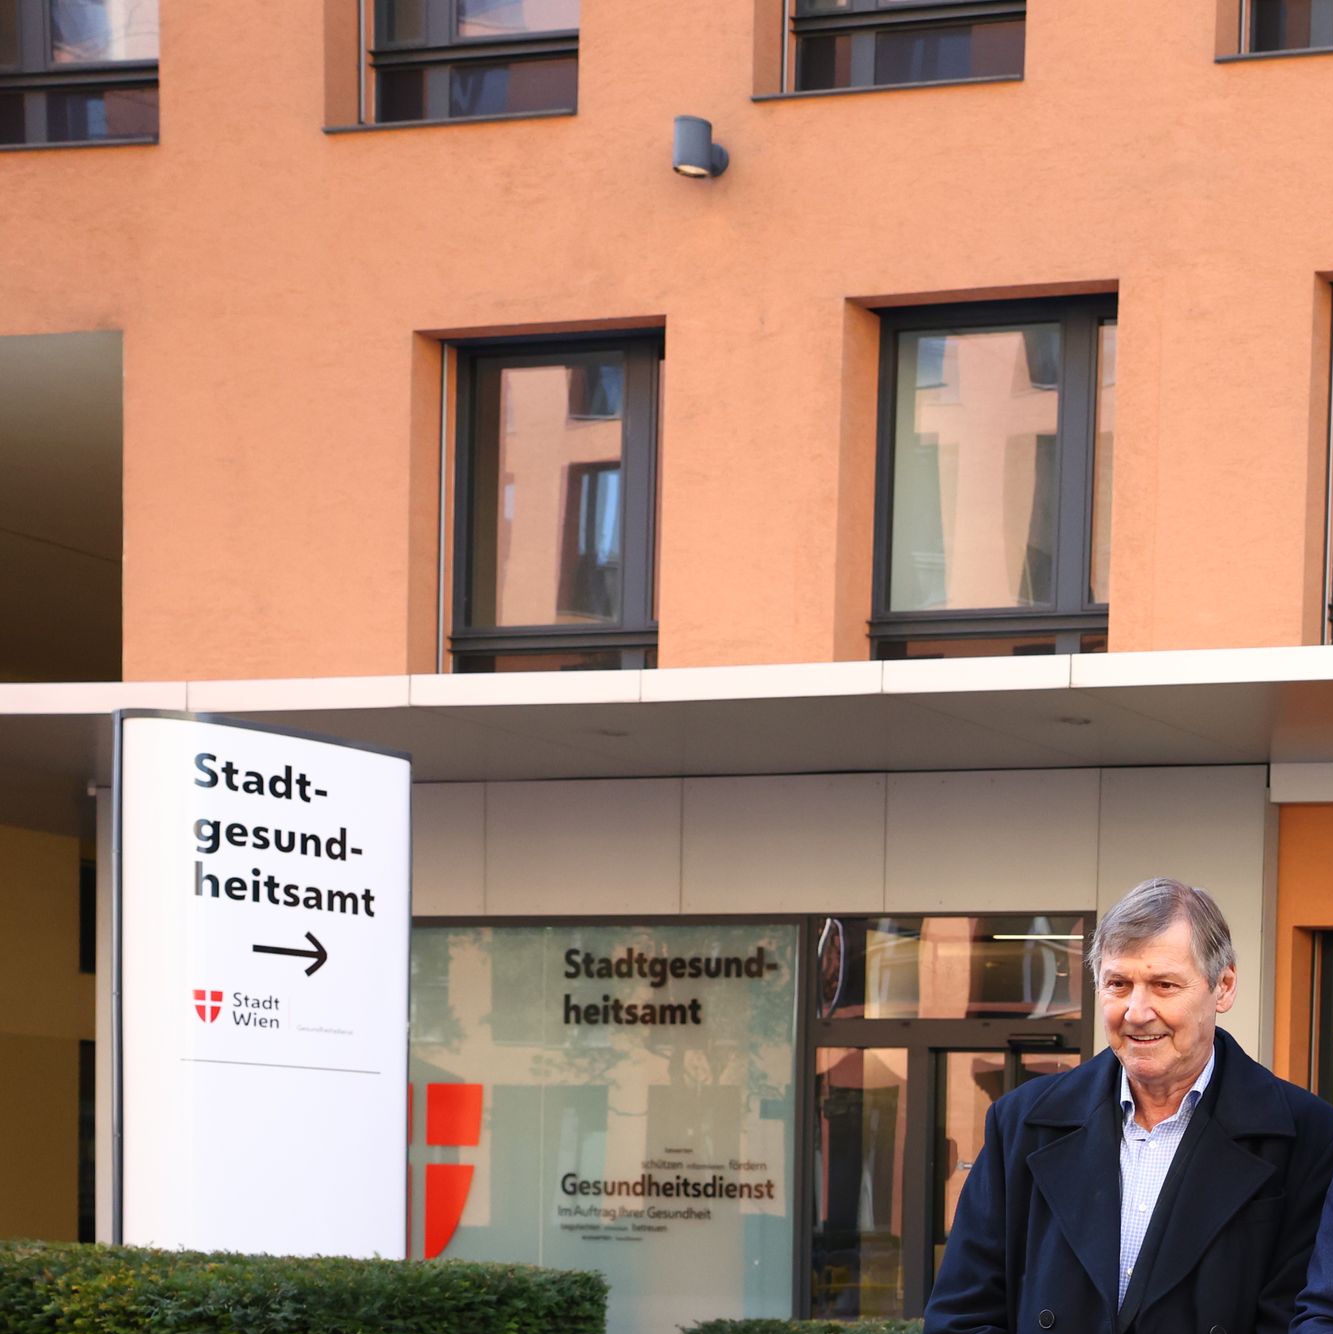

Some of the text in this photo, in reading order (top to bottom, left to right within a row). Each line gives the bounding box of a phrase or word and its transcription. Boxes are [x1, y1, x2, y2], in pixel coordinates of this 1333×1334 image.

[193, 752, 328, 803] Stadt-
[193, 818, 363, 861] gesund-
[194, 860, 375, 918] heitsamt
[564, 946, 778, 988] Stadtgesund-
[232, 992, 280, 1011] Stadt
[564, 993, 702, 1025] heitsamt
[232, 1010, 280, 1029] Wien
[561, 1173, 776, 1200] Gesundheitsdienst
[573, 1205, 617, 1222] Auftrag
[647, 1207, 712, 1220] Gesundheit
